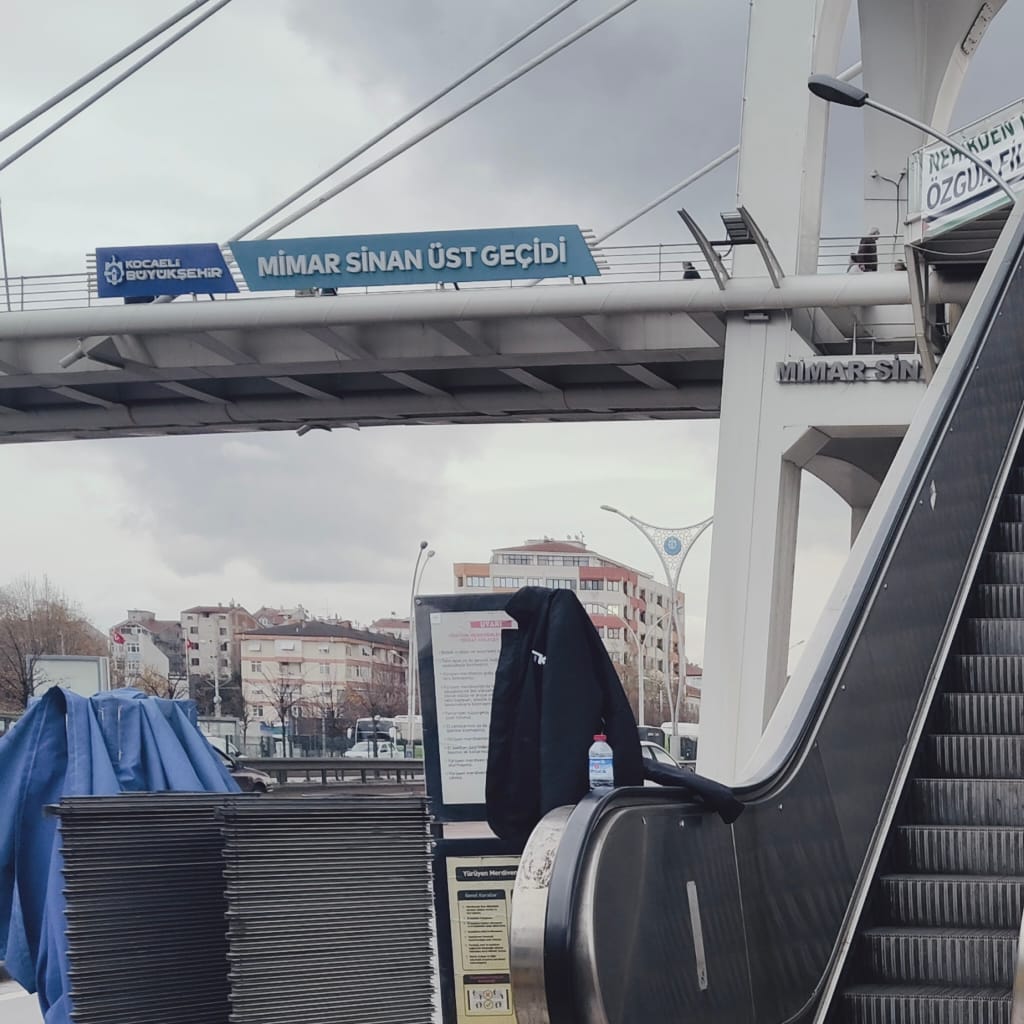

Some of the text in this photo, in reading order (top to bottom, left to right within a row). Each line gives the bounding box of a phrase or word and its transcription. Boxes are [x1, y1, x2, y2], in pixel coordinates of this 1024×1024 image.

[125, 259, 181, 269] KOCAELİ
[257, 236, 567, 277] MİMAR SİNAN ÜST GEÇİDİ
[125, 267, 223, 281] BÜYÜKŞEHİR
[874, 354, 922, 382] SİN
